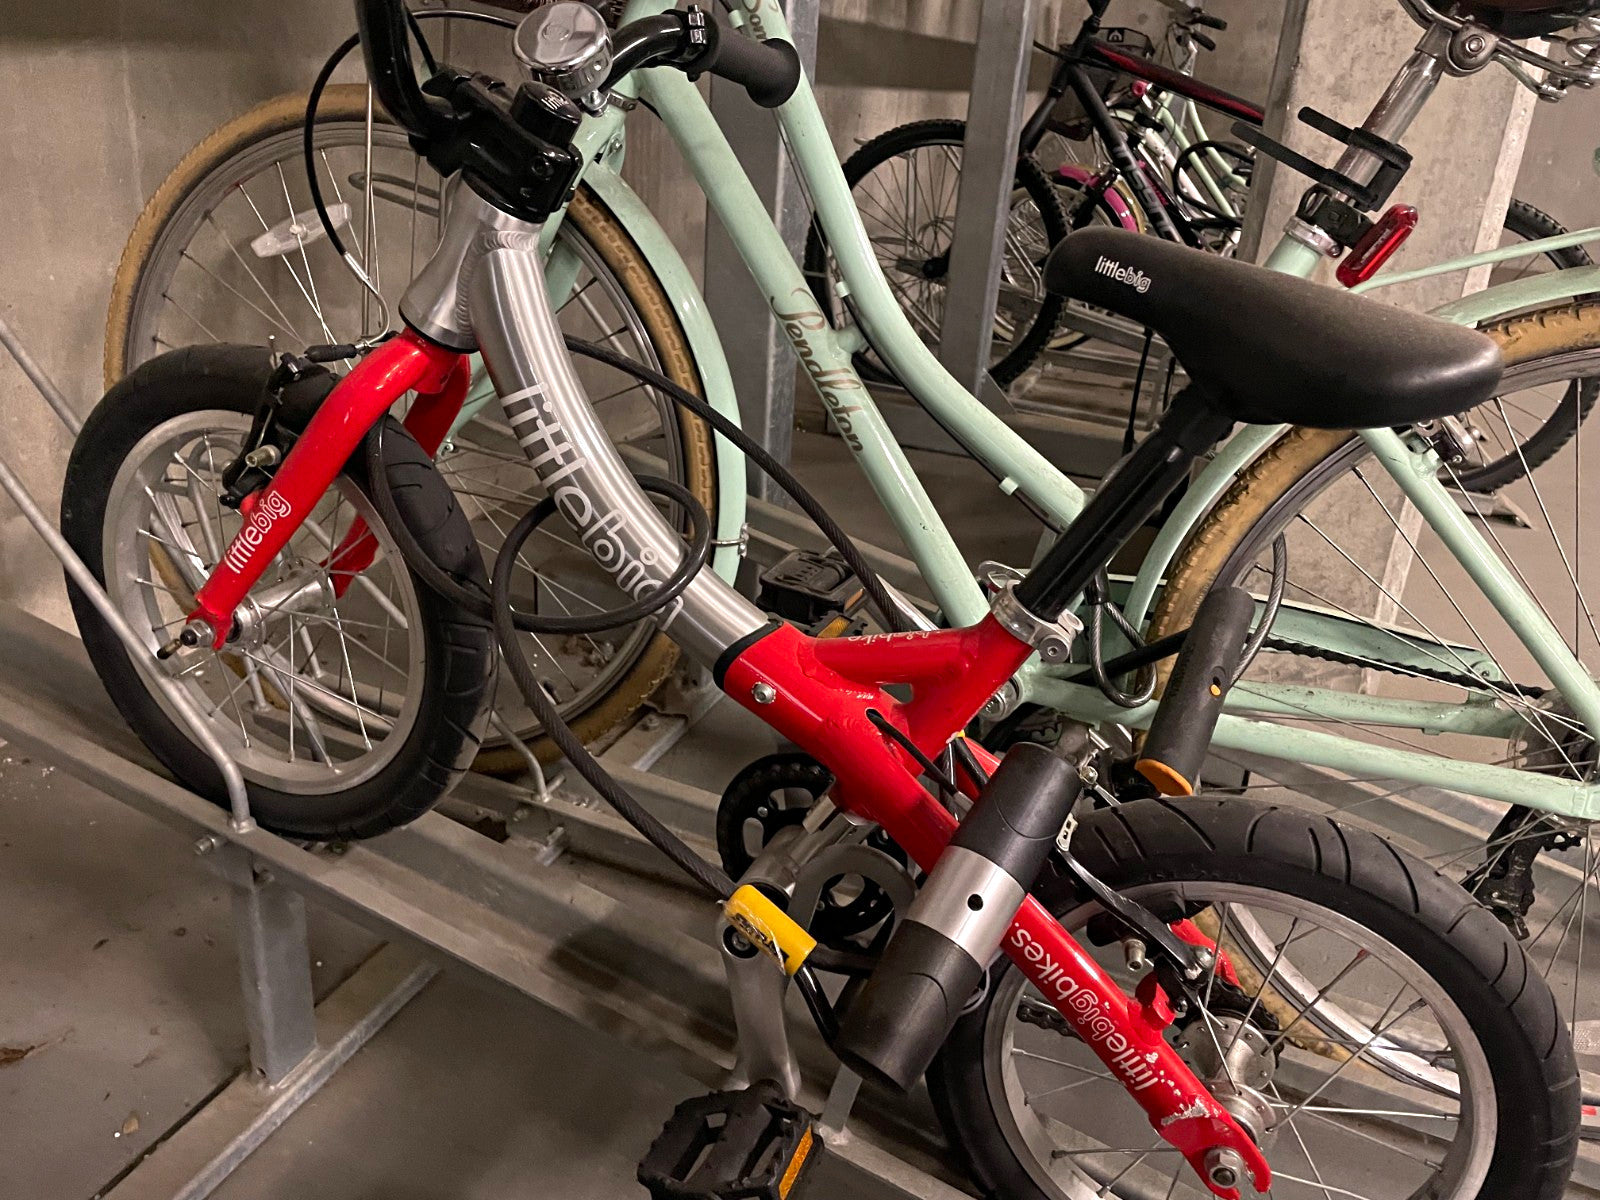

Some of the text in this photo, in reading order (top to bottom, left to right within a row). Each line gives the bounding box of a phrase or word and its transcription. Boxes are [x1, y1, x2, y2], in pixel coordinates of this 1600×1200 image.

[1094, 254, 1152, 294] littlebig
[770, 287, 864, 452] Pendleton
[224, 490, 292, 574] littlebig
[1010, 921, 1159, 1091] littlebigbikes.
